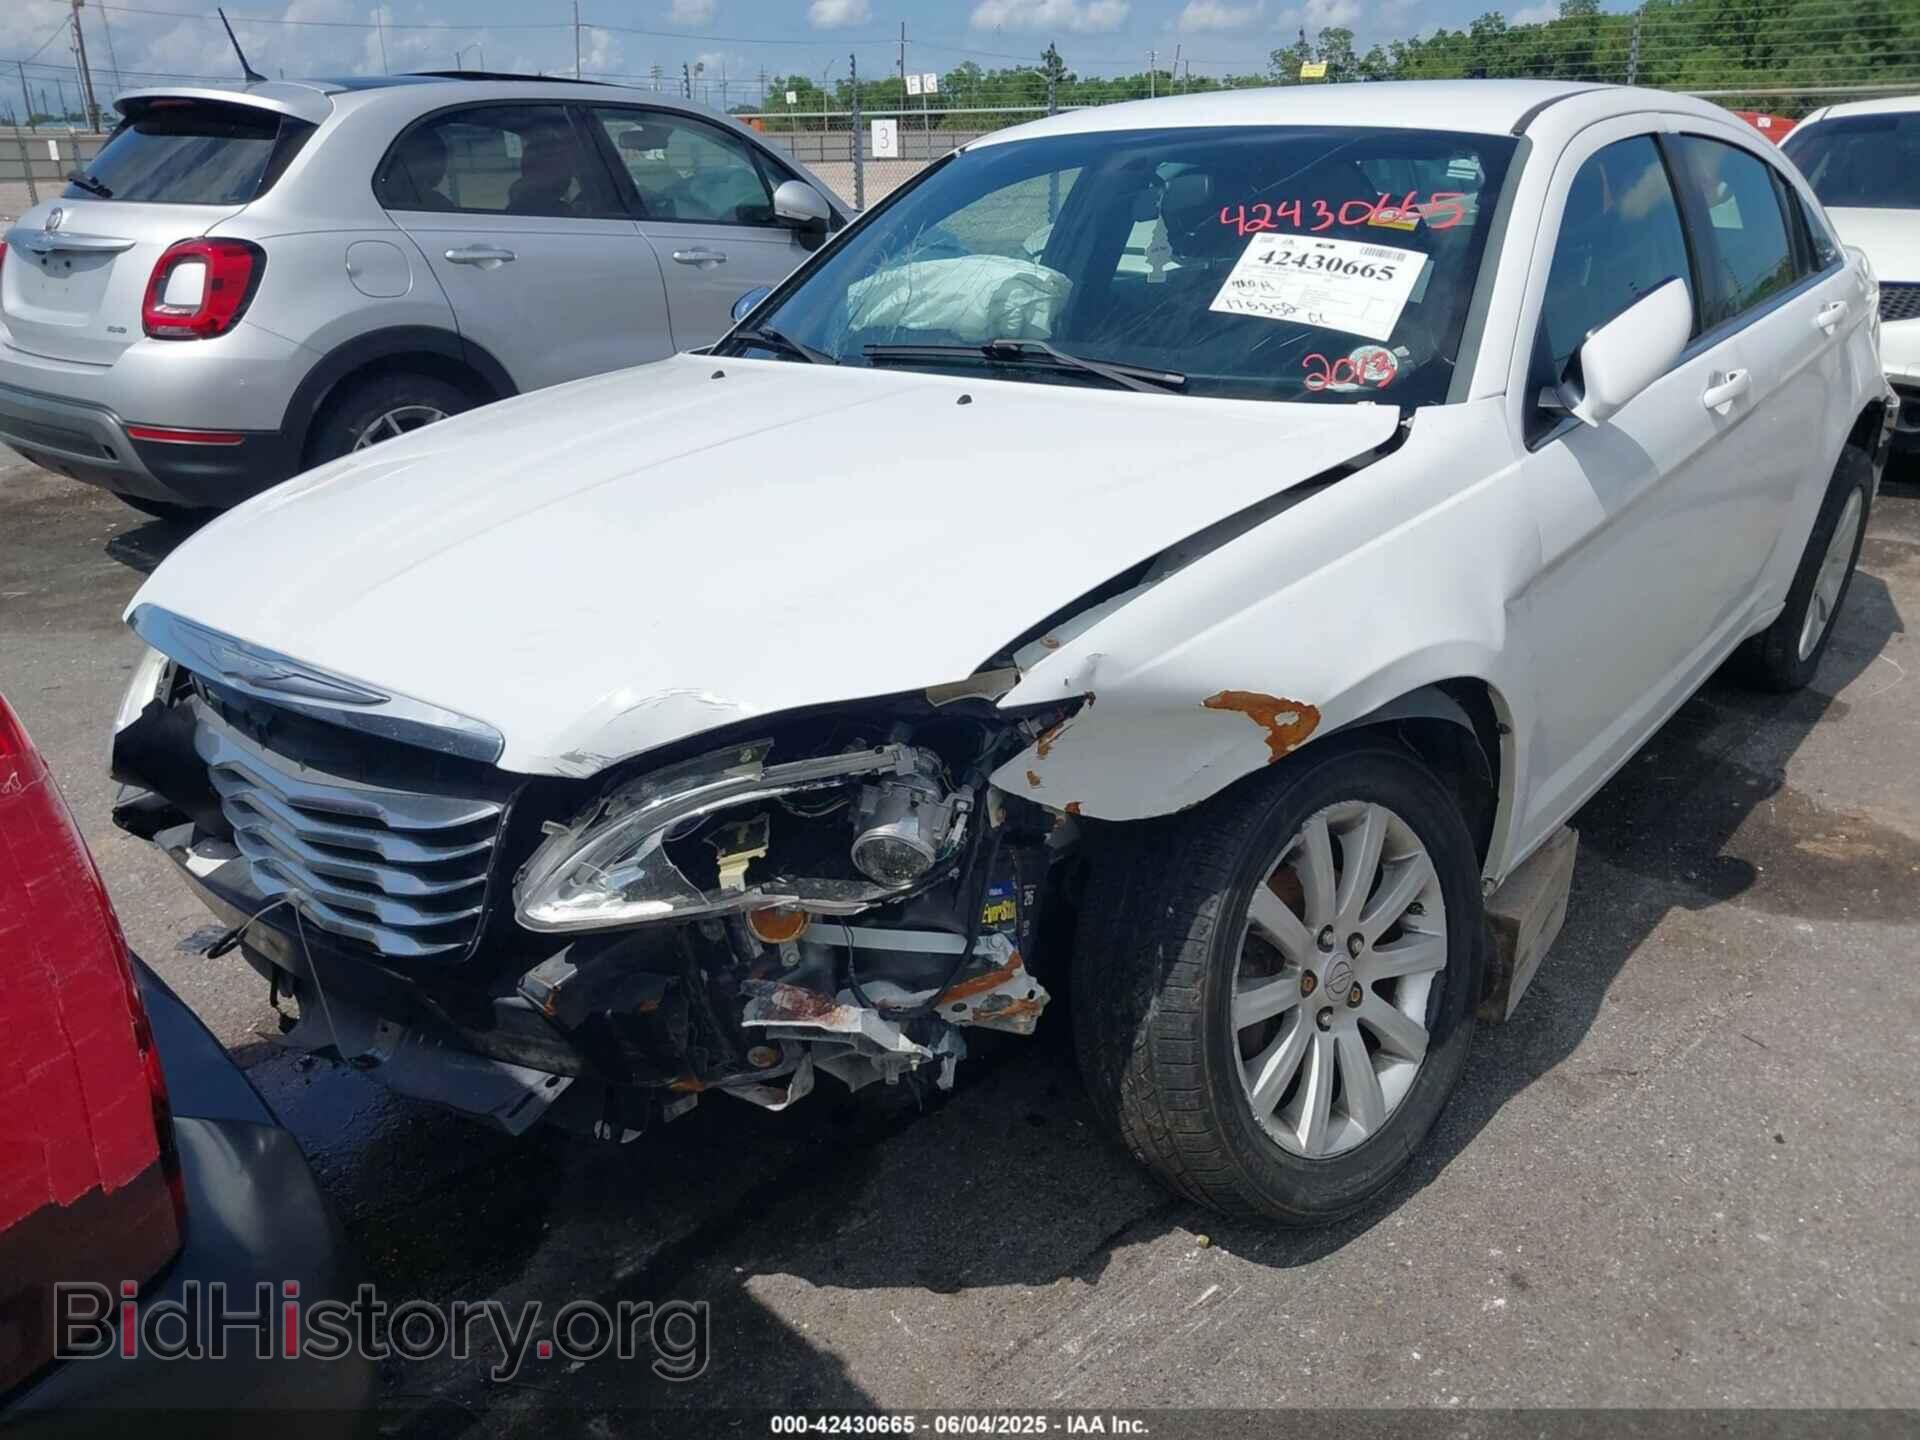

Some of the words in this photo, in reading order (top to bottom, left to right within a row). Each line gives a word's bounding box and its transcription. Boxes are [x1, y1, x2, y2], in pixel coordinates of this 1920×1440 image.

[879, 127, 890, 149] 3
[1219, 191, 1467, 237] 42430665
[1258, 249, 1396, 281] 42430665
[1302, 352, 1397, 392] 2013
